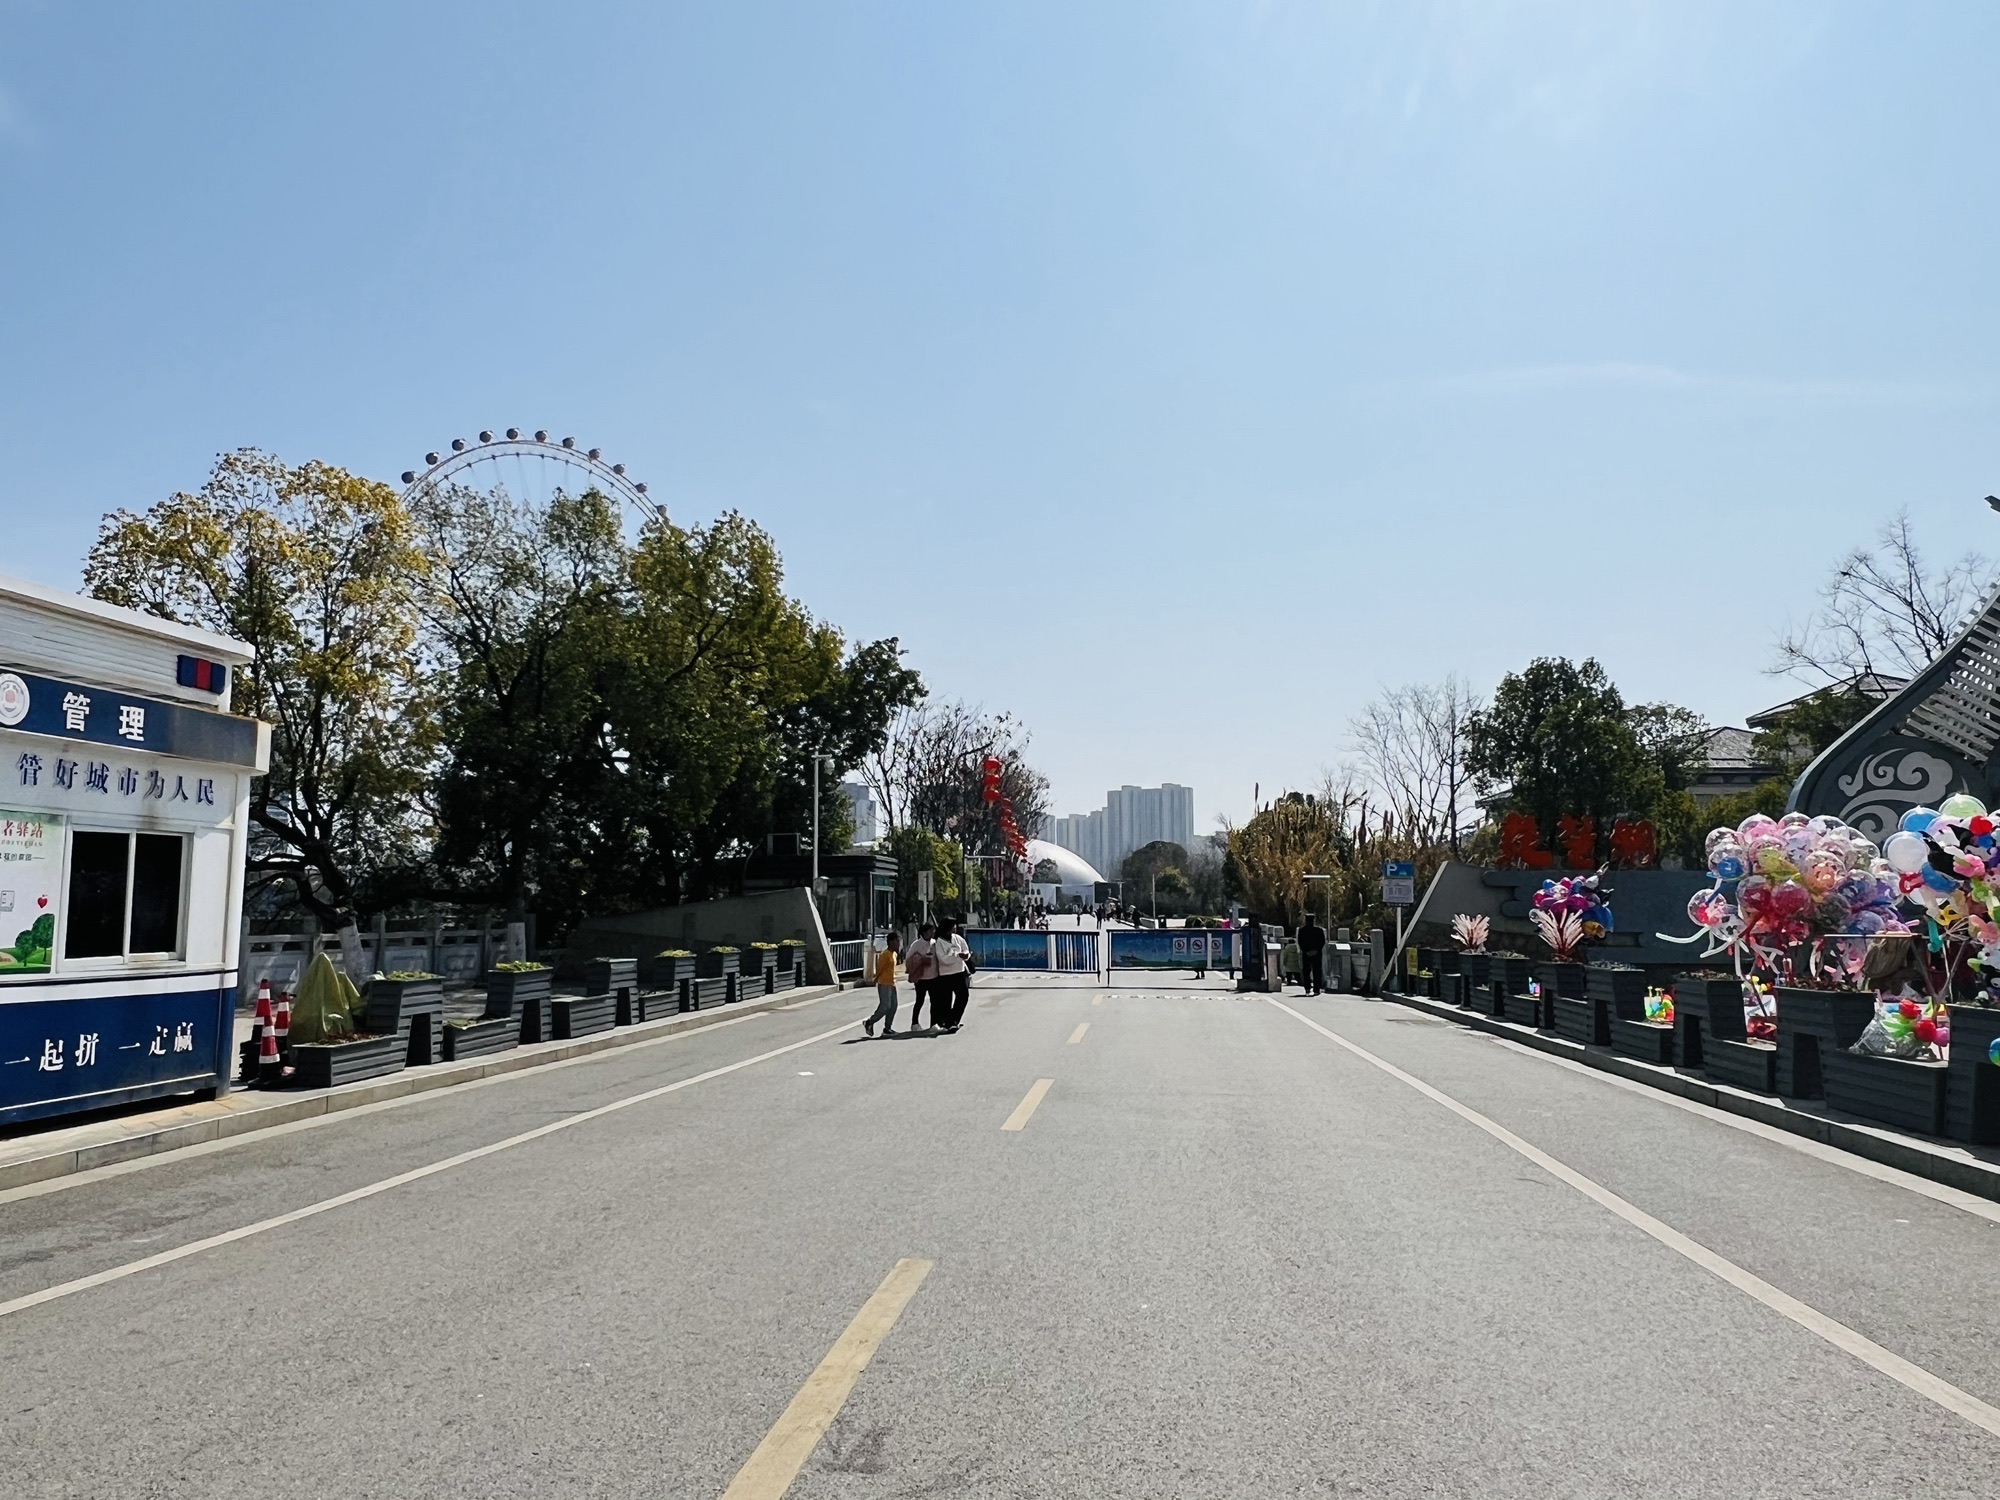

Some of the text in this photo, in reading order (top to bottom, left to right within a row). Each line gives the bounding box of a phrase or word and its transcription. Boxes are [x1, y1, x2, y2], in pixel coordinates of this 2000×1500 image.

[62, 691, 145, 742] 管理
[17, 752, 215, 805] 管好城市为人民
